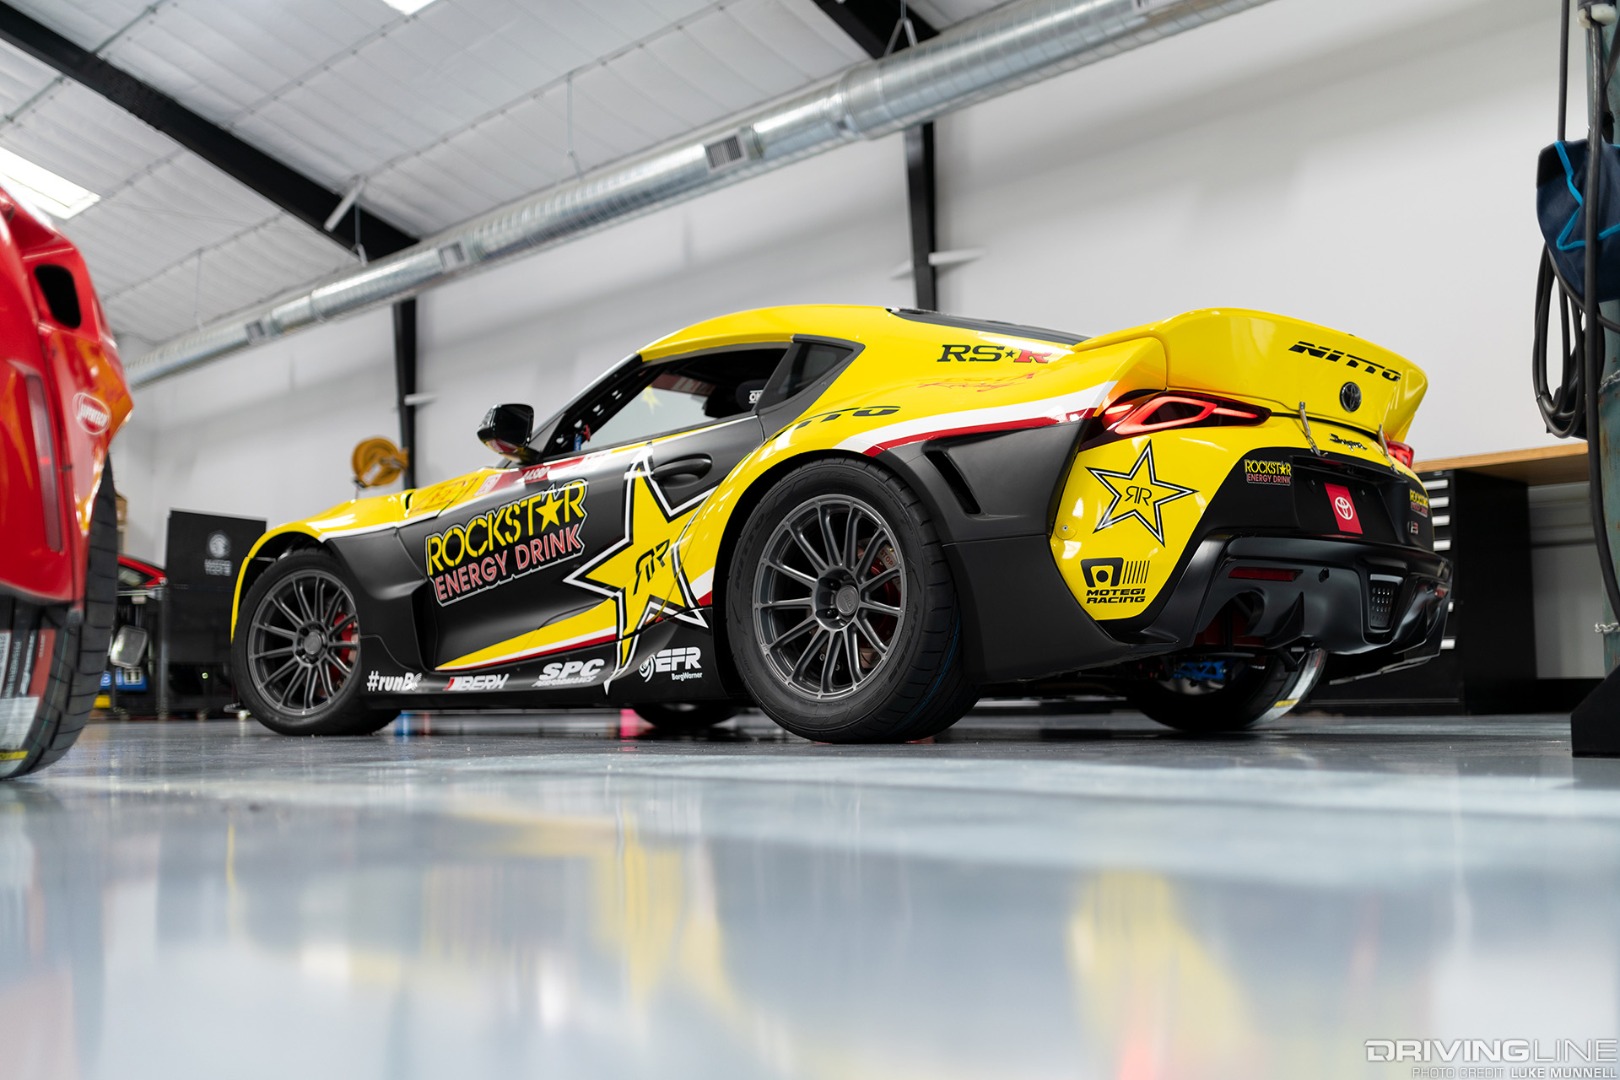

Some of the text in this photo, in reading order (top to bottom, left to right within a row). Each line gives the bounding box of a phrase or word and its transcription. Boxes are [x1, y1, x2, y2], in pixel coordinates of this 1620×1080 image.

[1288, 341, 1401, 382] NITTO
[1245, 459, 1291, 475] ROCKSTAR
[1247, 473, 1271, 482] ENERGY
[427, 480, 585, 576] ROCKSTAR
[435, 524, 581, 601] ENERGY DRINK
[1086, 588, 1146, 597] MOTEGI
[1086, 596, 1147, 604] RACING
[538, 658, 605, 680] SPC
[655, 646, 702, 672] EFR
